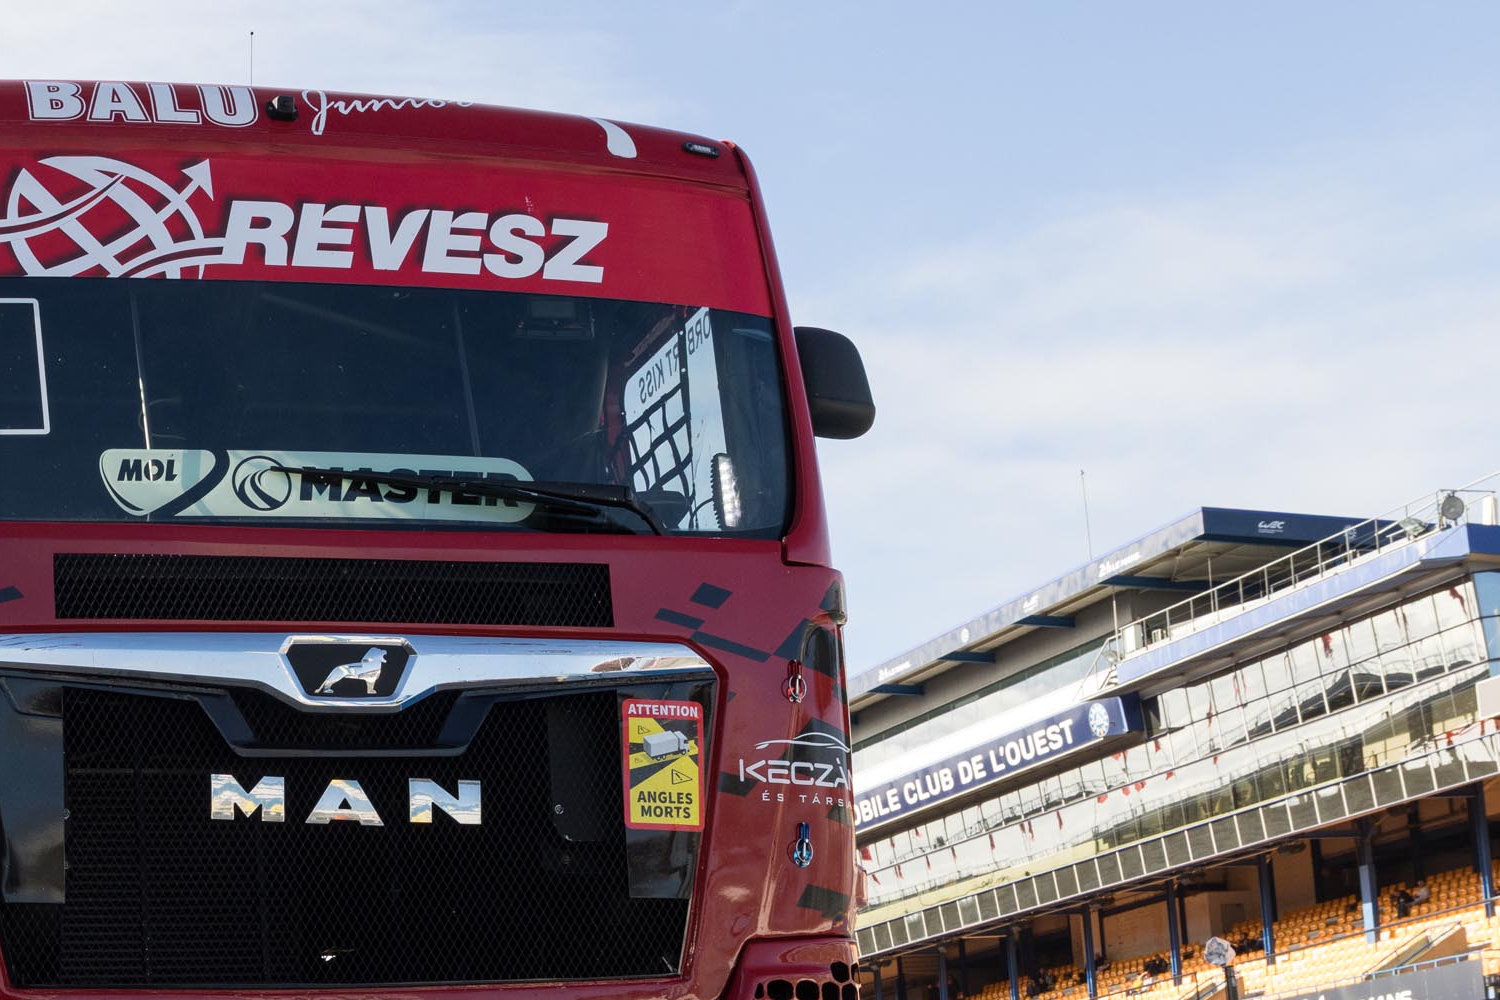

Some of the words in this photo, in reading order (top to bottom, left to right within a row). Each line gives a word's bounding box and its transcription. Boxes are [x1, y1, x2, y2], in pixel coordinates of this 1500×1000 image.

[24, 79, 260, 128] BALU
[301, 88, 475, 136] Junio
[222, 199, 609, 284] REVESZ
[116, 458, 178, 482] MOL
[628, 703, 698, 718] ATTENTION
[903, 769, 955, 805] CLUB
[957, 754, 987, 786] DE
[990, 719, 1074, 774] L'OUEST
[210, 773, 483, 827] MAN
[637, 790, 693, 805] ANGLES
[640, 805, 691, 819] MORTS
[762, 790, 784, 802] ÉS
